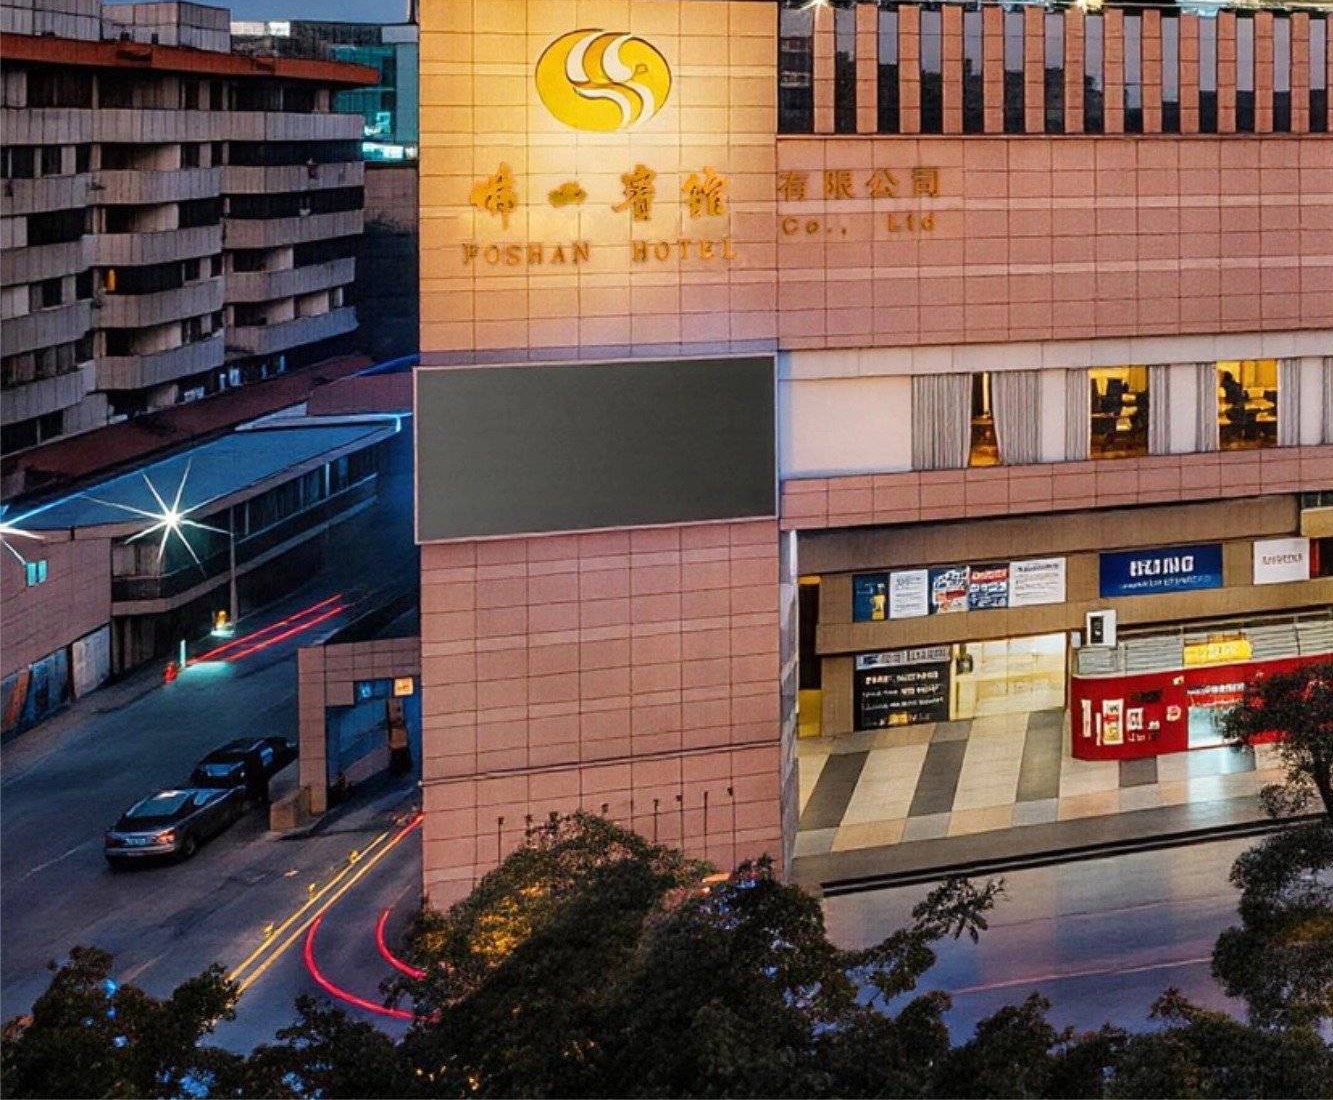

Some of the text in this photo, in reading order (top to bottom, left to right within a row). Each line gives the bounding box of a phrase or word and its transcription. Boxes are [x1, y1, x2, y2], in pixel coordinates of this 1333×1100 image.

[777, 166, 940, 201] 有限公司
[886, 211, 935, 233] Ltd
[462, 235, 738, 266] FOSHAN HOTEL
